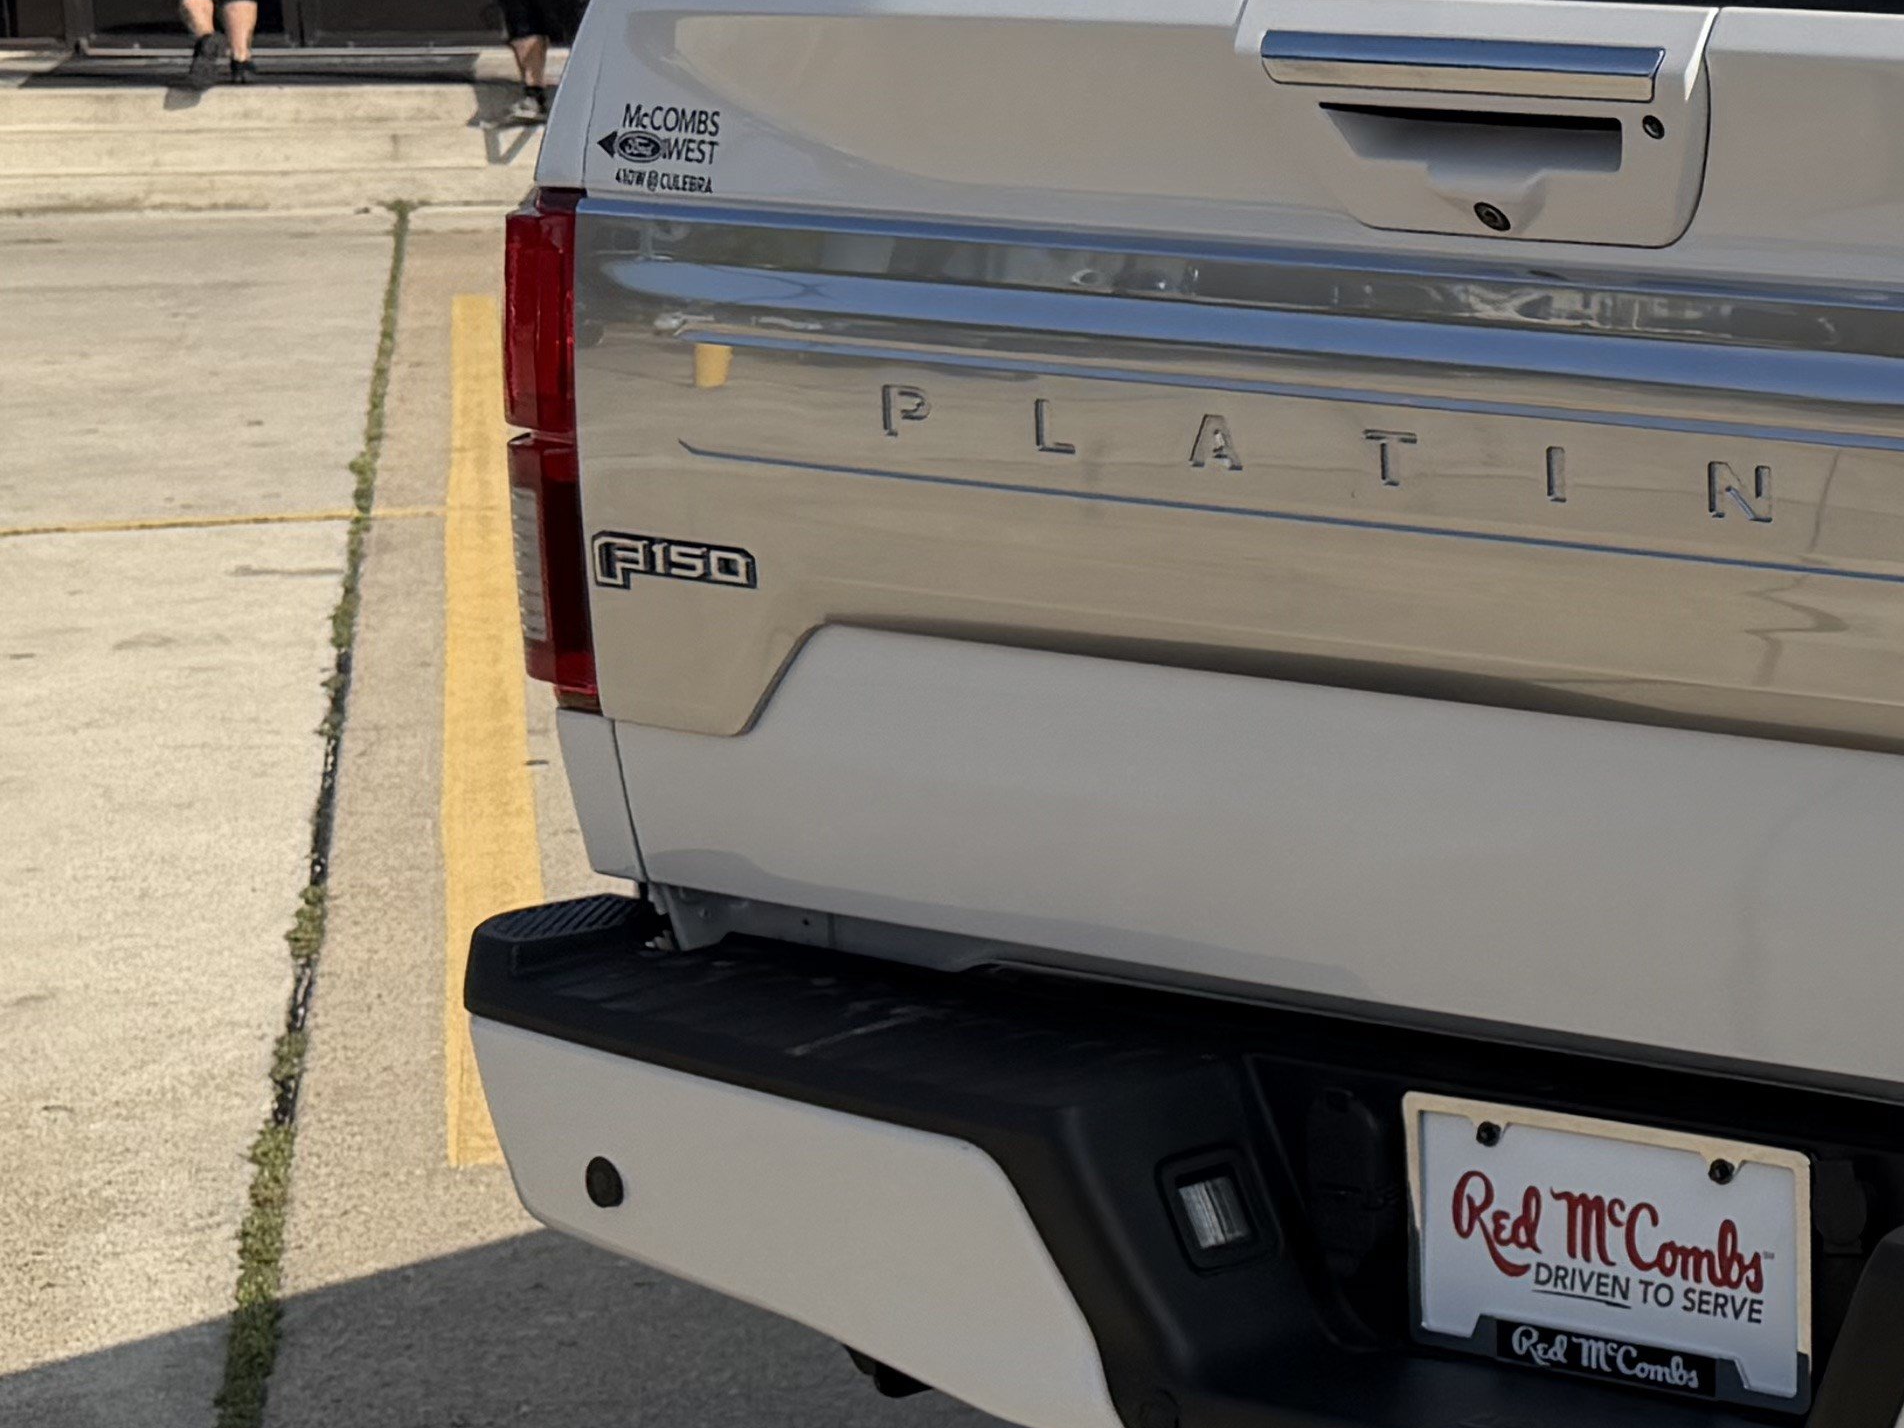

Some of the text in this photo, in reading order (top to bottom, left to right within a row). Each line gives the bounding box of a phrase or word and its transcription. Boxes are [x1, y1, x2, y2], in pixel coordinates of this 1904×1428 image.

[622, 103, 720, 137] McCOMBS
[661, 137, 719, 165] WEST
[1452, 1170, 1764, 1294] Red McCombs
[1534, 1262, 1764, 1325] DRIVEN TO SERVE
[1512, 1325, 1699, 1389] Red McCombs
